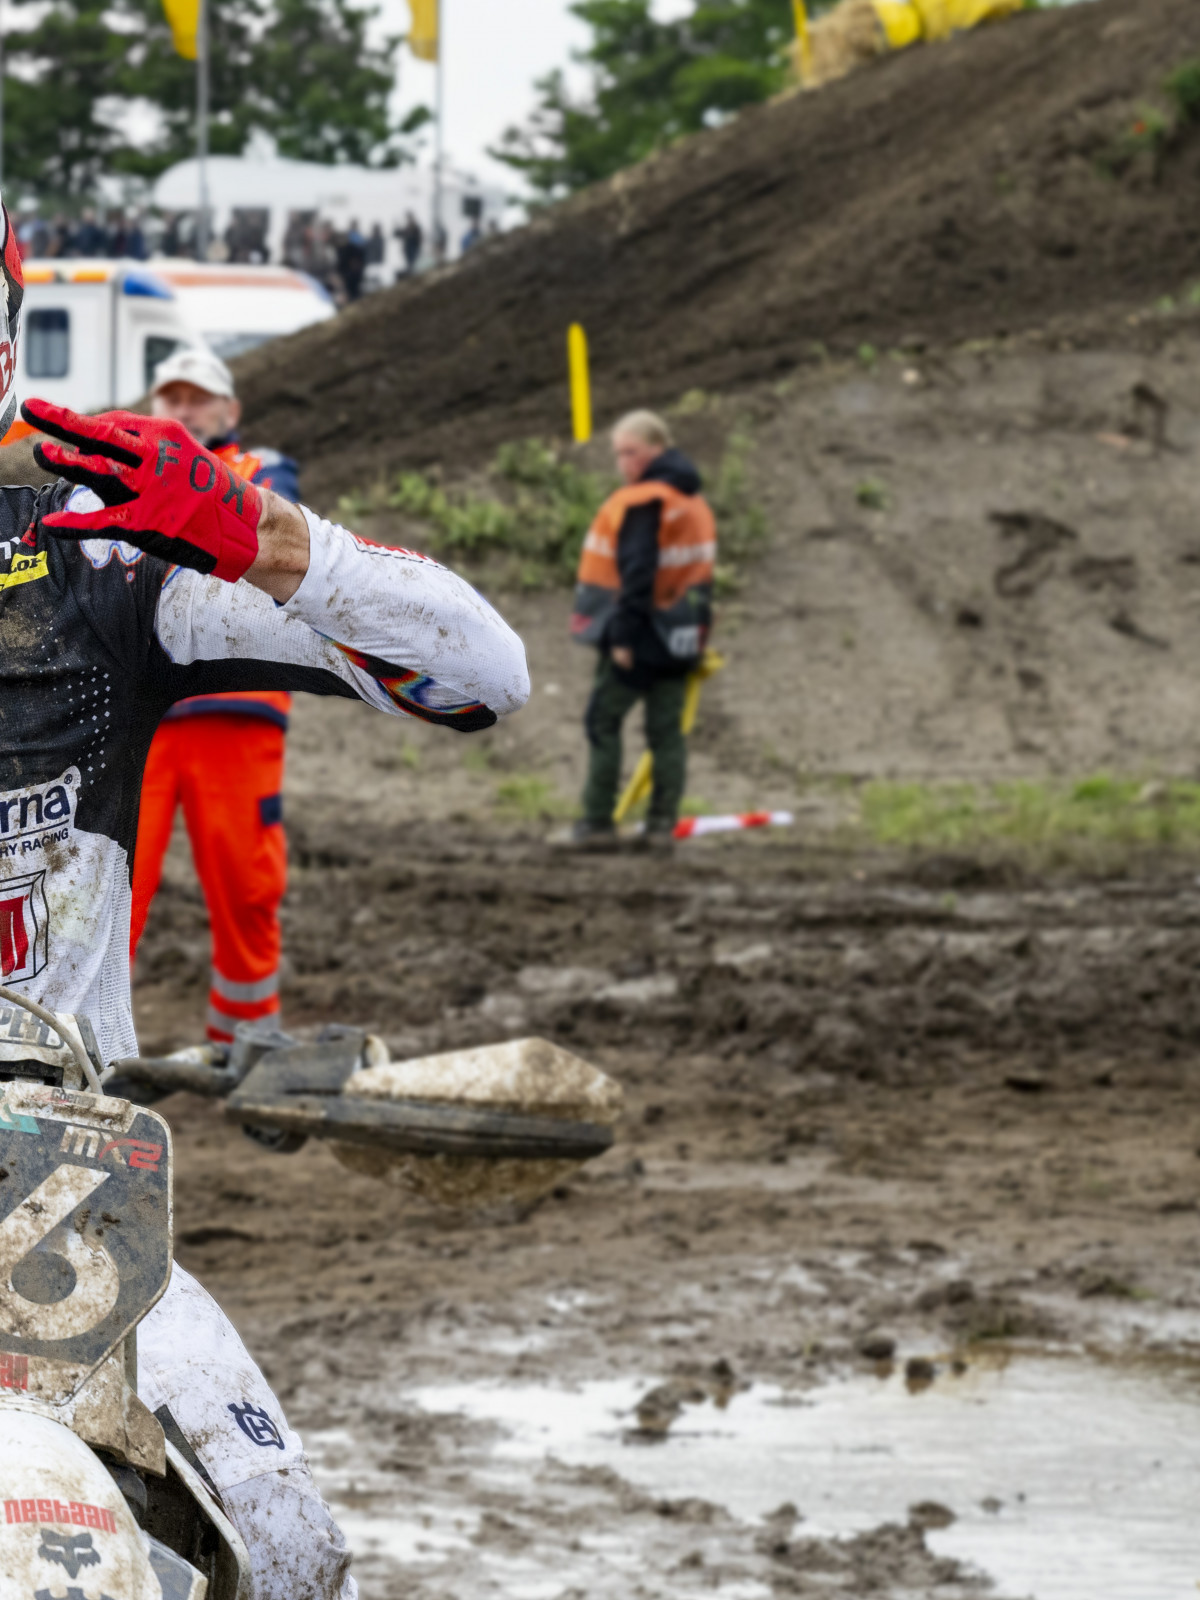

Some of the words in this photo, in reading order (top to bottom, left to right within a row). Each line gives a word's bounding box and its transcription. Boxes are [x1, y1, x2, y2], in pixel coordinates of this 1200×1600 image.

[154, 439, 247, 516] FOX
[21, 827, 69, 854] RACING
[3, 1498, 118, 1535] nestaan
